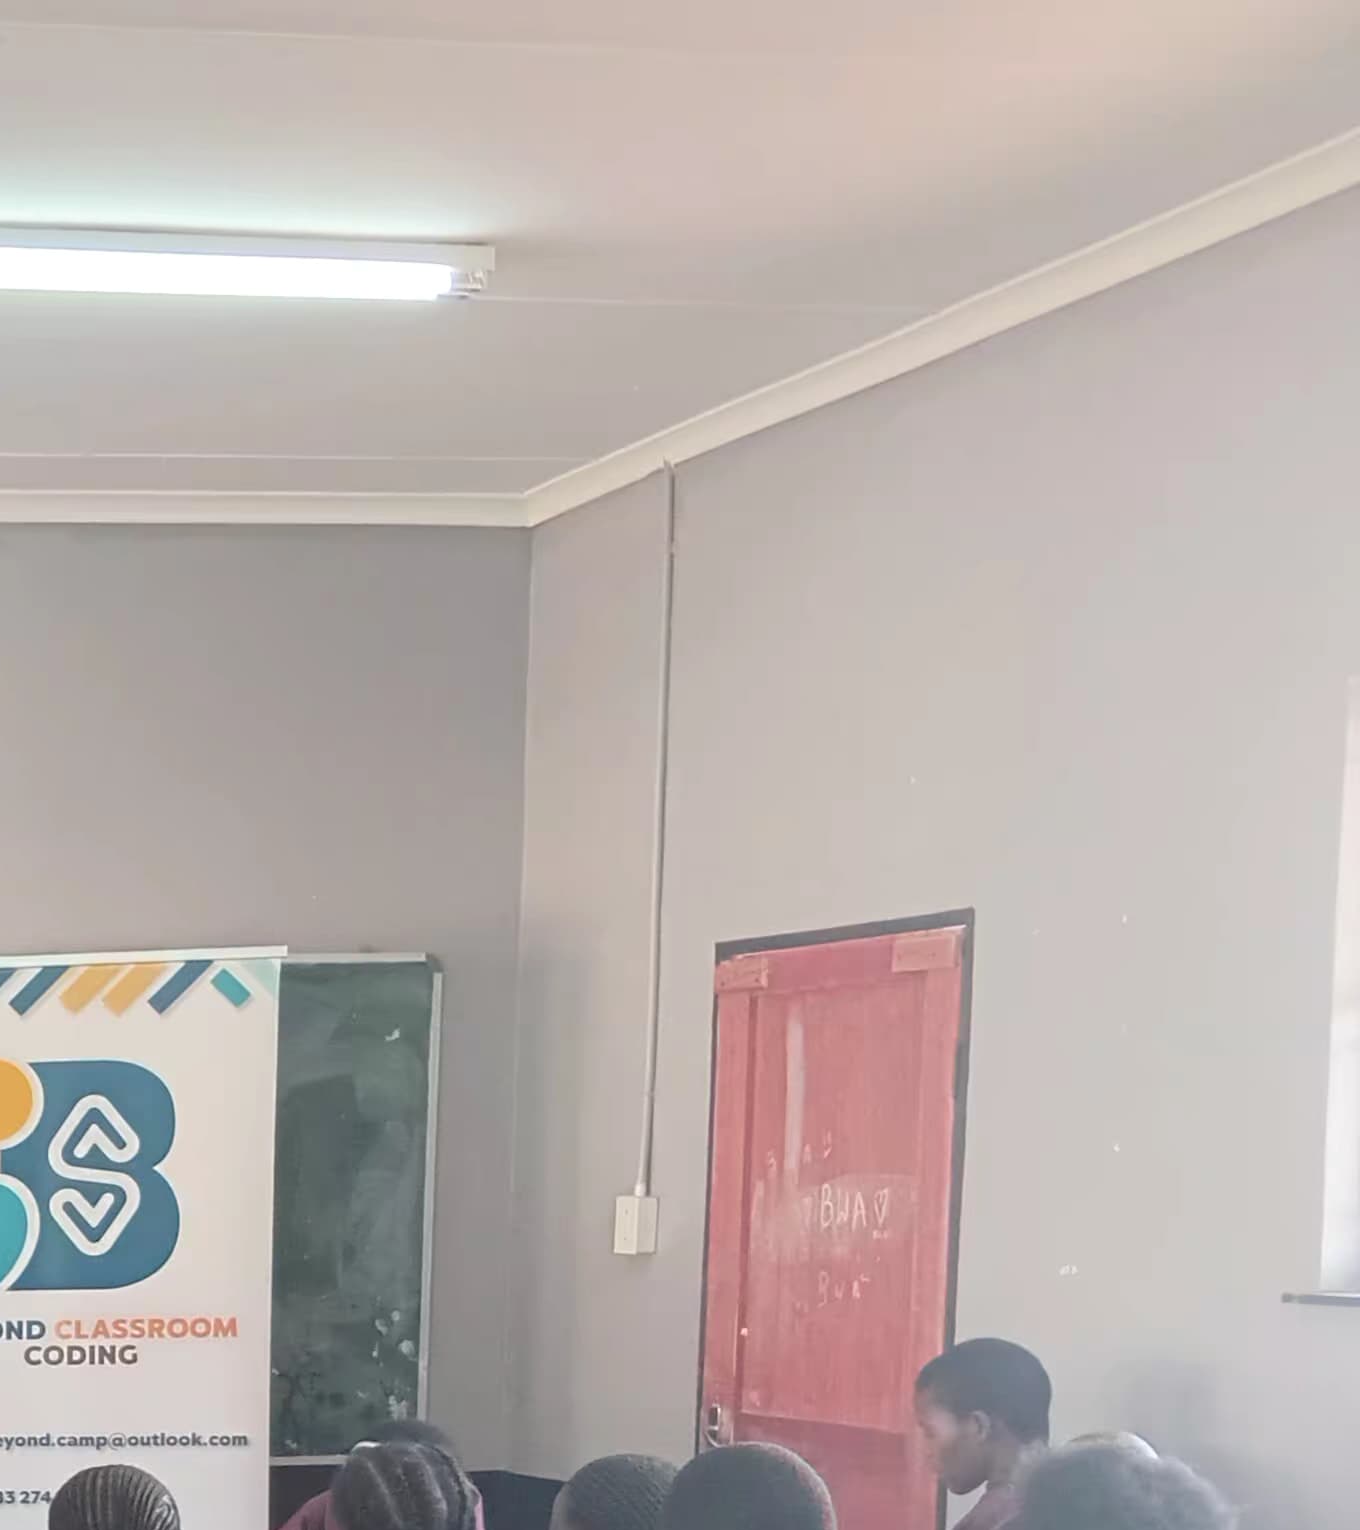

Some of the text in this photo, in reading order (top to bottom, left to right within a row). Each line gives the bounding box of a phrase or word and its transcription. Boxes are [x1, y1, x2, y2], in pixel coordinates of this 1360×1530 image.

[54, 1317, 238, 1339] CLASSROOM
[23, 1344, 138, 1365] CODING
[19, 1490, 52, 1504] 274
